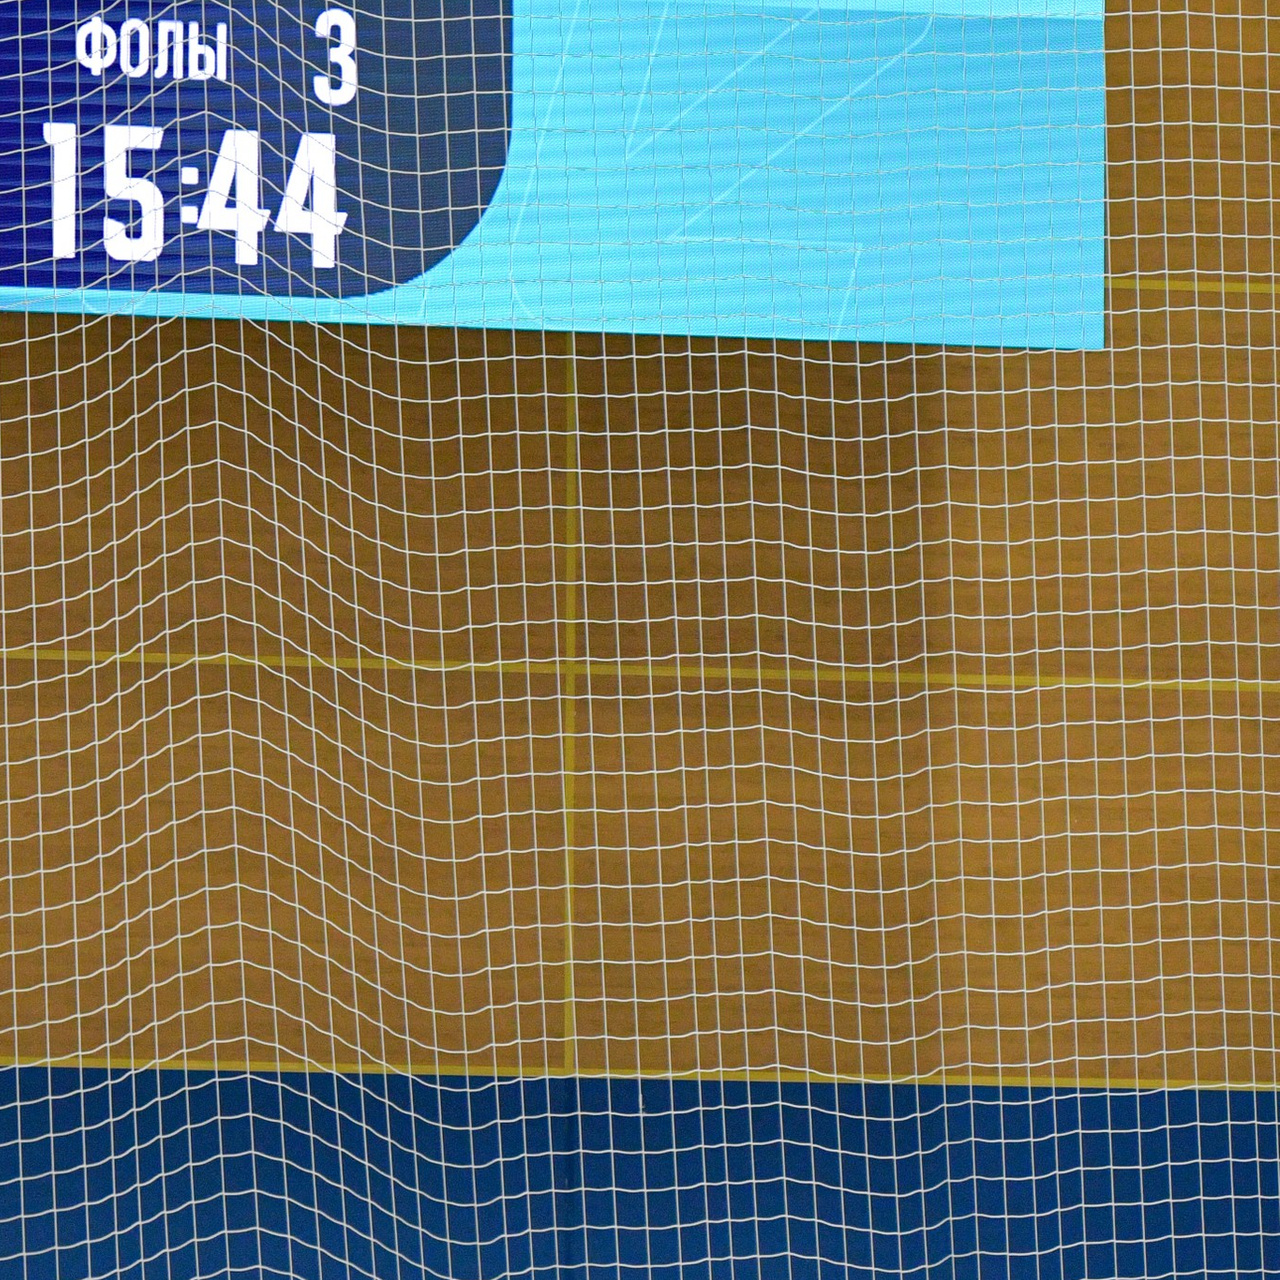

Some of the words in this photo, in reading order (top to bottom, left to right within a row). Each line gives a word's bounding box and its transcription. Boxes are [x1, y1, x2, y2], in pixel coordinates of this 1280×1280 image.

[76, 17, 227, 81] ФОЛЫ
[313, 8, 357, 106] 3
[43, 122, 348, 269] 15:44
